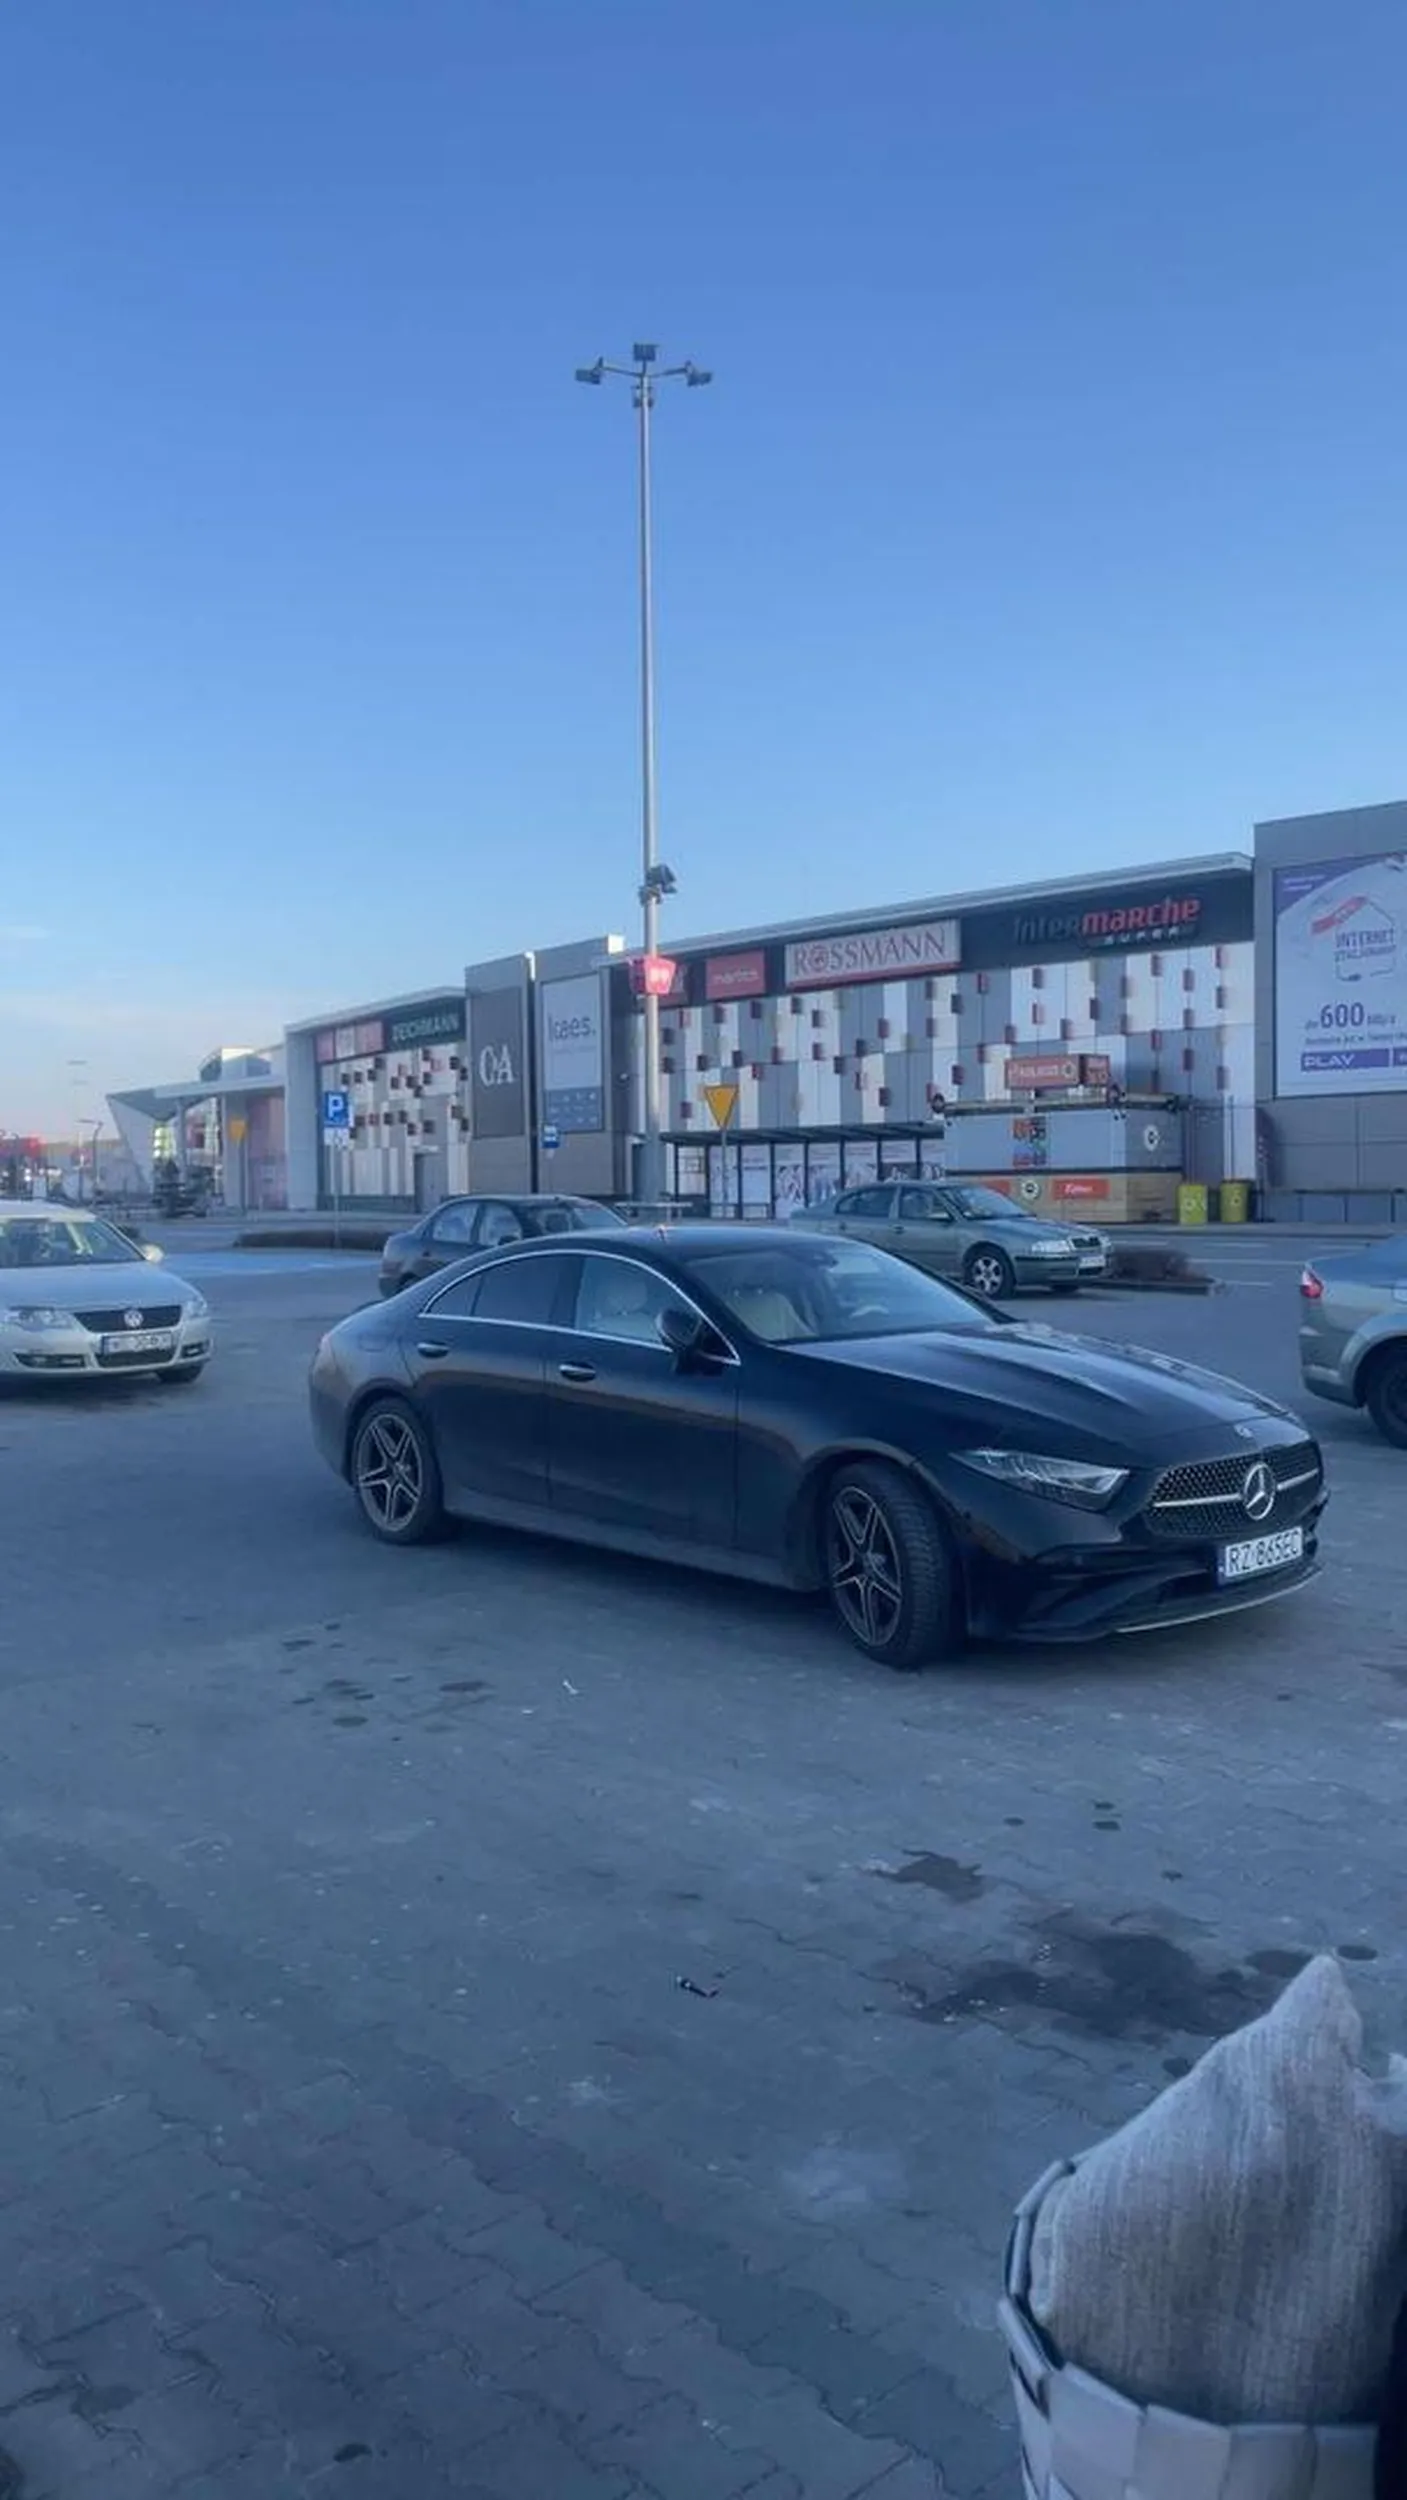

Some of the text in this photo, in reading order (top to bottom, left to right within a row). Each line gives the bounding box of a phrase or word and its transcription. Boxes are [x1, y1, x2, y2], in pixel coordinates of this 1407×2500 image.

[793, 925, 946, 977] ROSSMANN
[1320, 1002, 1365, 1029] 600
[1304, 1053, 1355, 1067] PLAY
[328, 1094, 344, 1117] P
